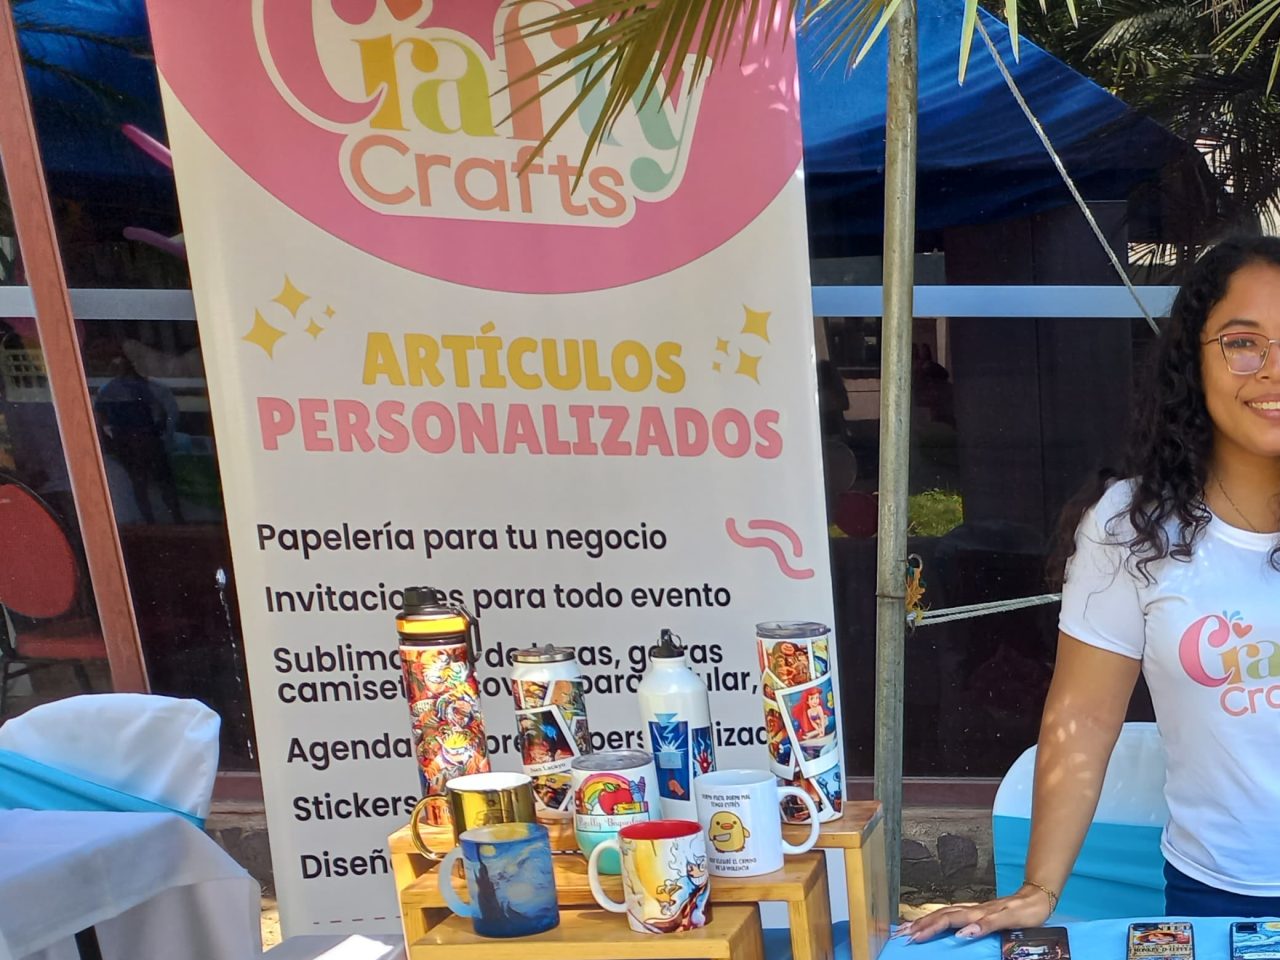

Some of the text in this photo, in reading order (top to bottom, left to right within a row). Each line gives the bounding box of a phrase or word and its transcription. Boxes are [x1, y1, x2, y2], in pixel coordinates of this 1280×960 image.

[349, 134, 627, 218] Crafts
[362, 321, 686, 394] ARTÍCULOS
[256, 396, 784, 460] PERSONALIZADOS
[257, 521, 667, 560] Papelería para tu negocio
[265, 582, 731, 618] Invitacioes para todo evento
[293, 792, 418, 822] Stickers
[301, 849, 393, 879] Diseñ
